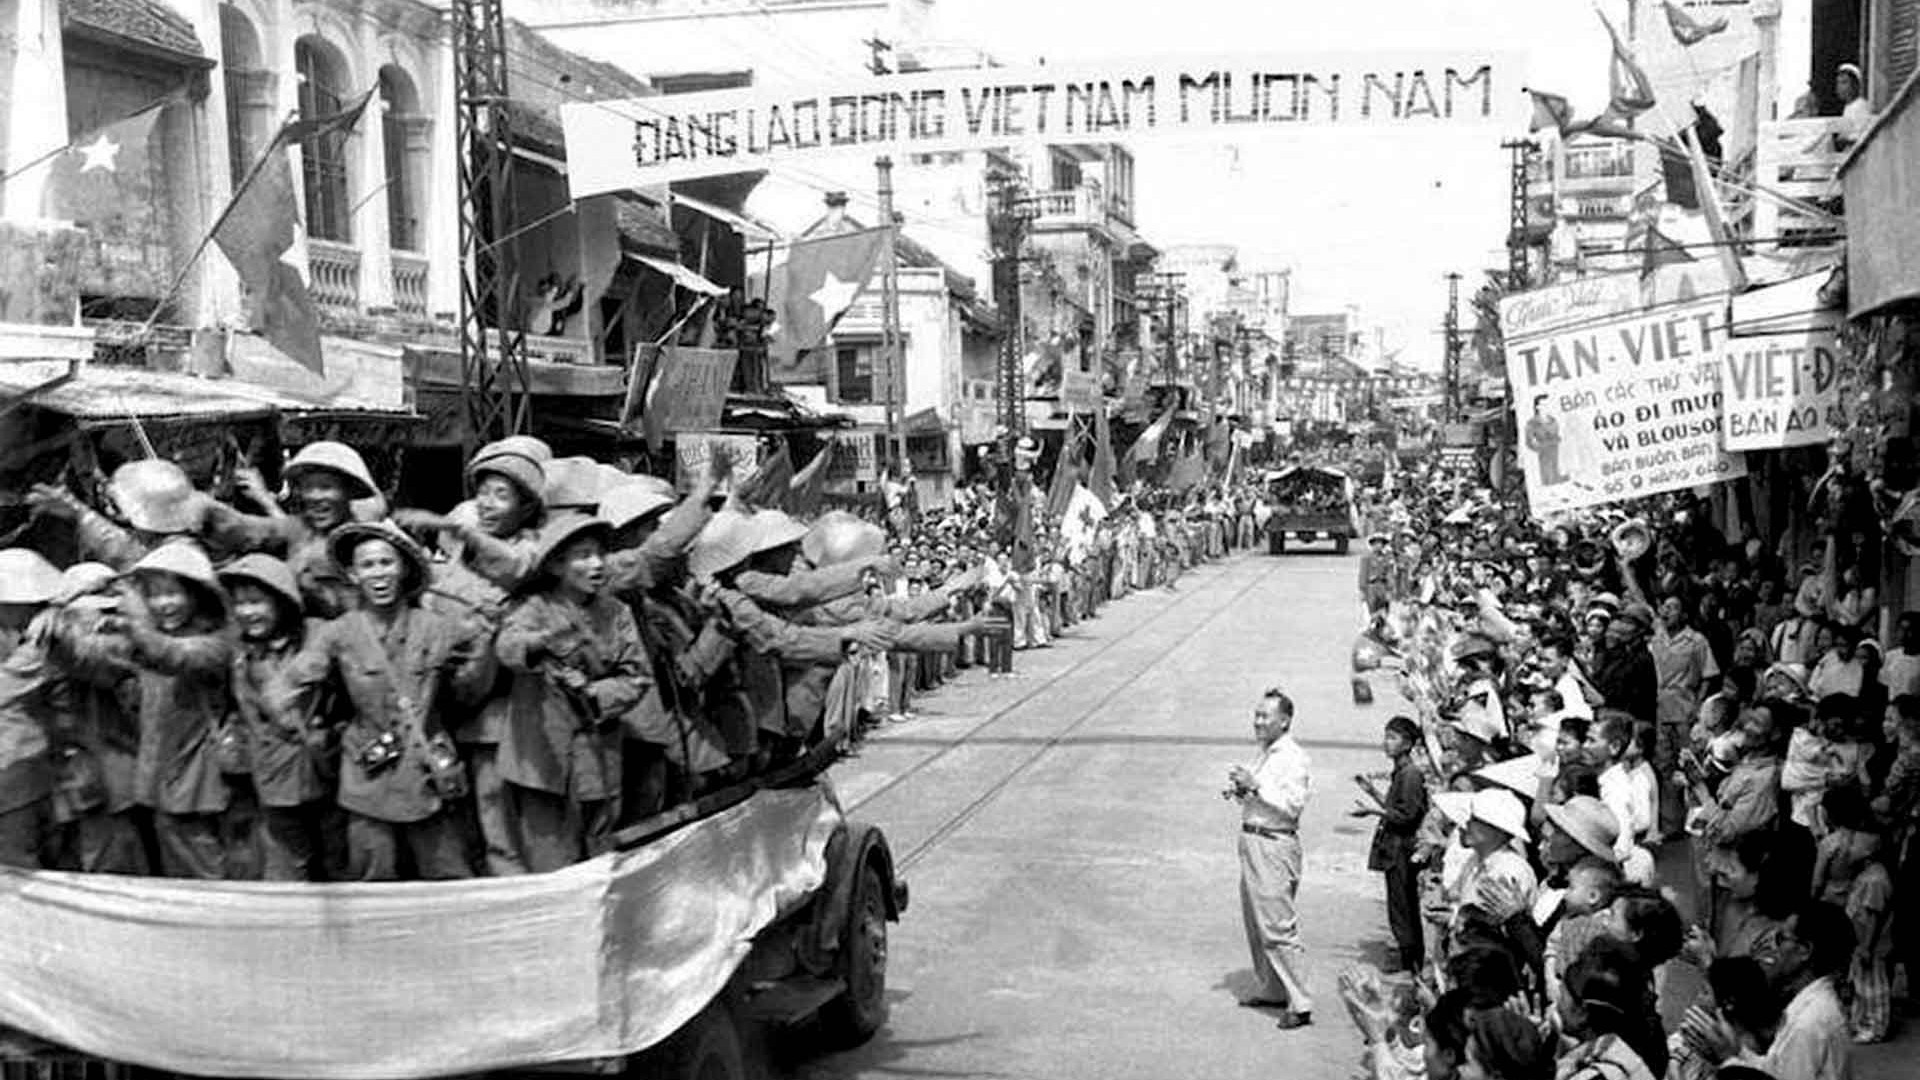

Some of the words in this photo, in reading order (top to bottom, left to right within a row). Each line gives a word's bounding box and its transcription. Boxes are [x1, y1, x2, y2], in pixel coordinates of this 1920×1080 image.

[747, 97, 821, 154] LAO
[1066, 76, 1155, 133] NAM
[1636, 403, 1660, 422] ĐI
